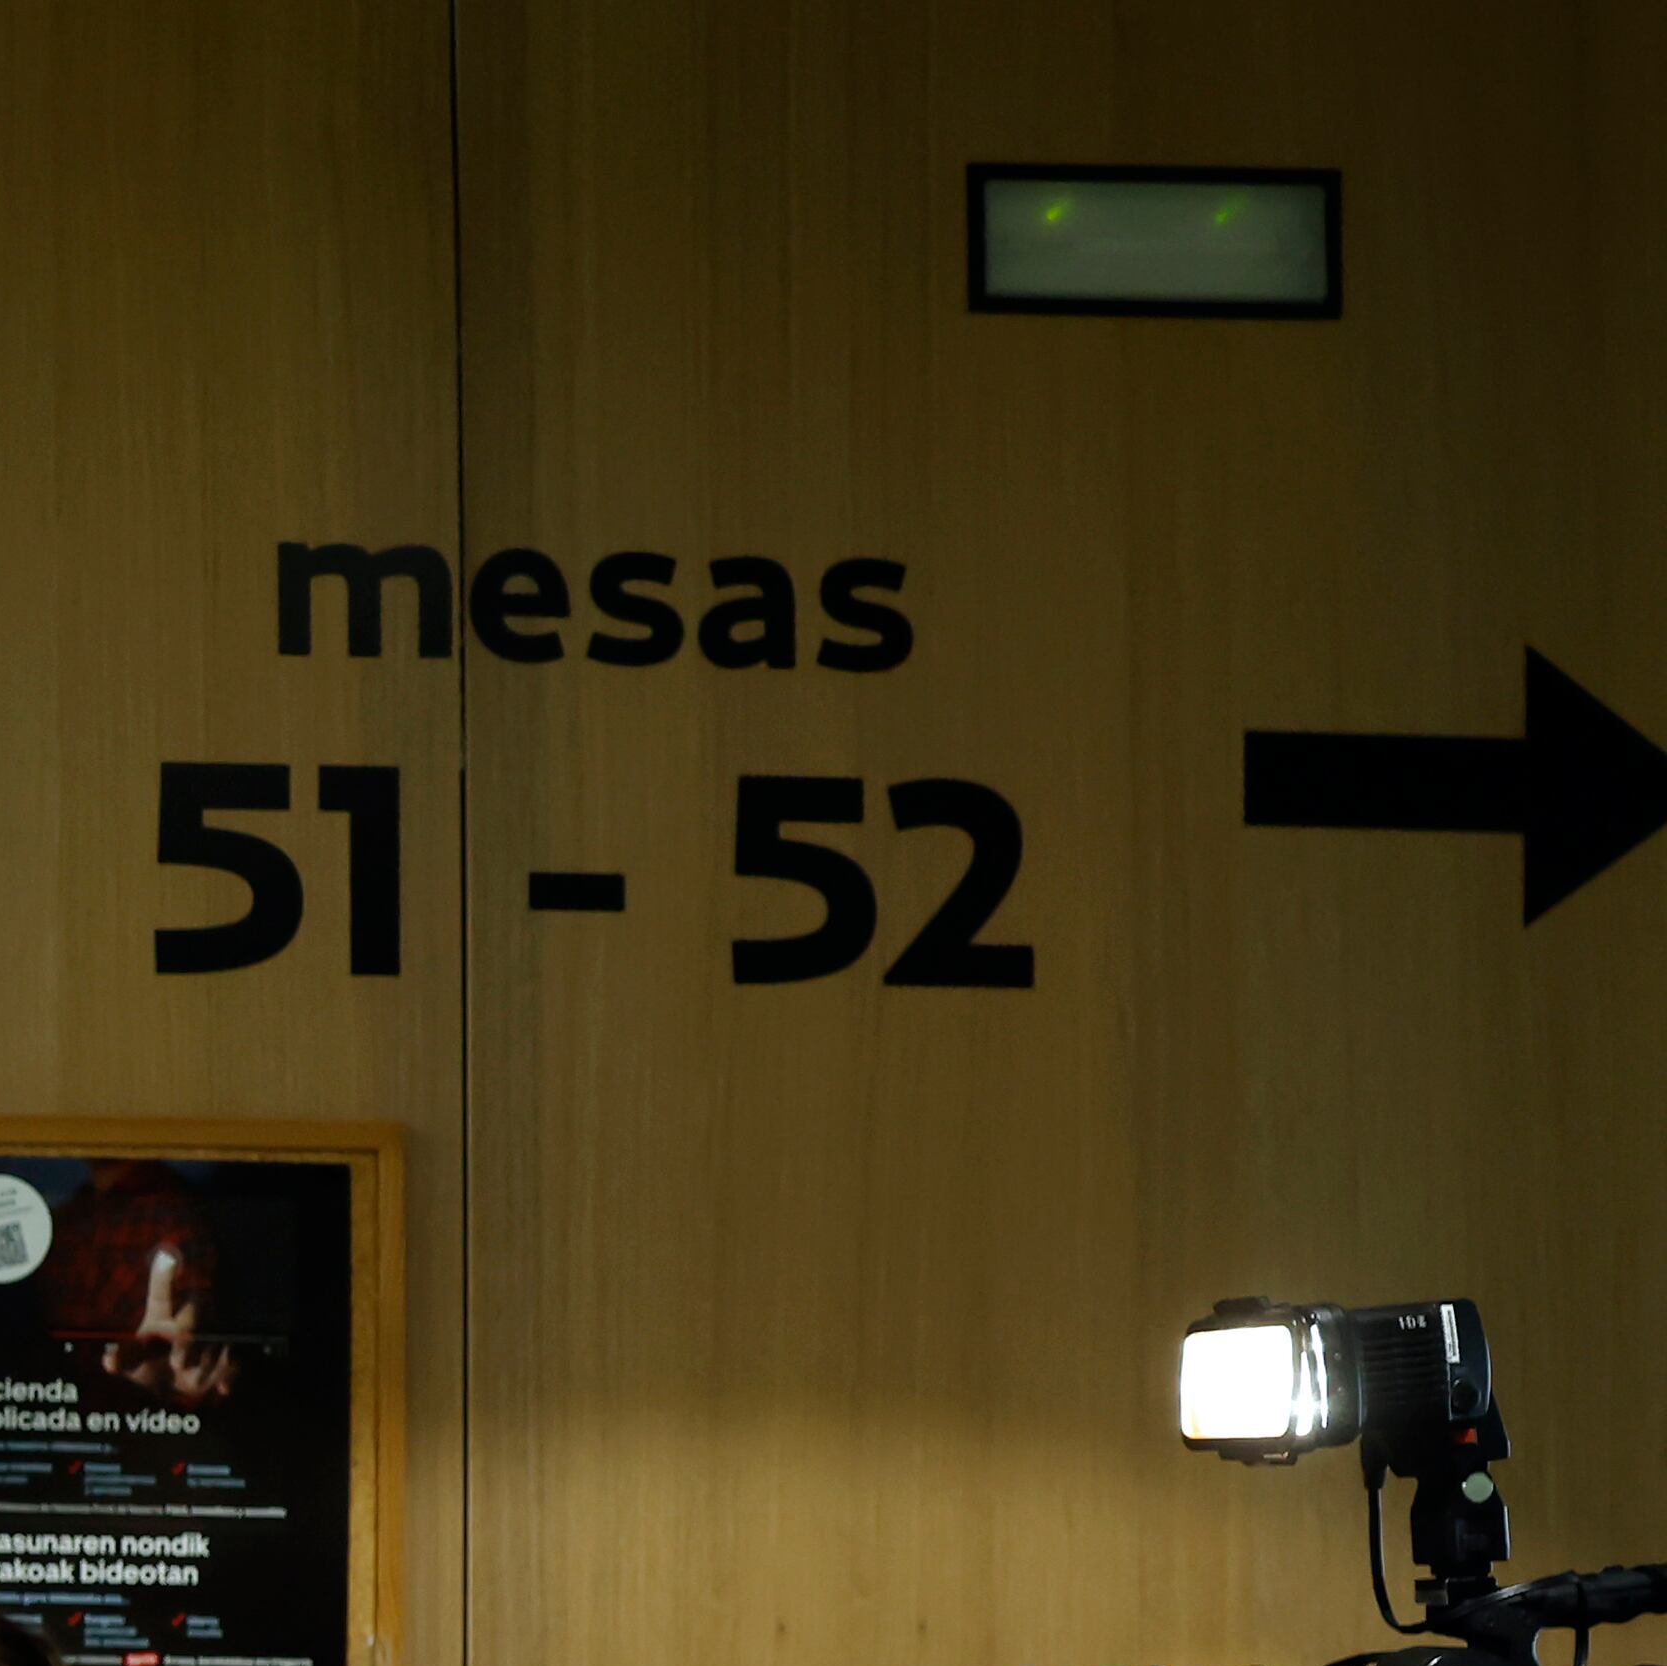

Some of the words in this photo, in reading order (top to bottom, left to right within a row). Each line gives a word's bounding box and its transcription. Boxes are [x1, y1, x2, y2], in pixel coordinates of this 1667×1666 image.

[277, 541, 915, 673] mesas
[154, 761, 401, 977] 51
[528, 871, 626, 913] -
[731, 774, 1035, 990] 52
[86, 1412, 120, 1434] en
[125, 1407, 201, 1435] vídeo
[120, 1530, 210, 1559] nondik
[79, 1559, 199, 1587] bideotan
